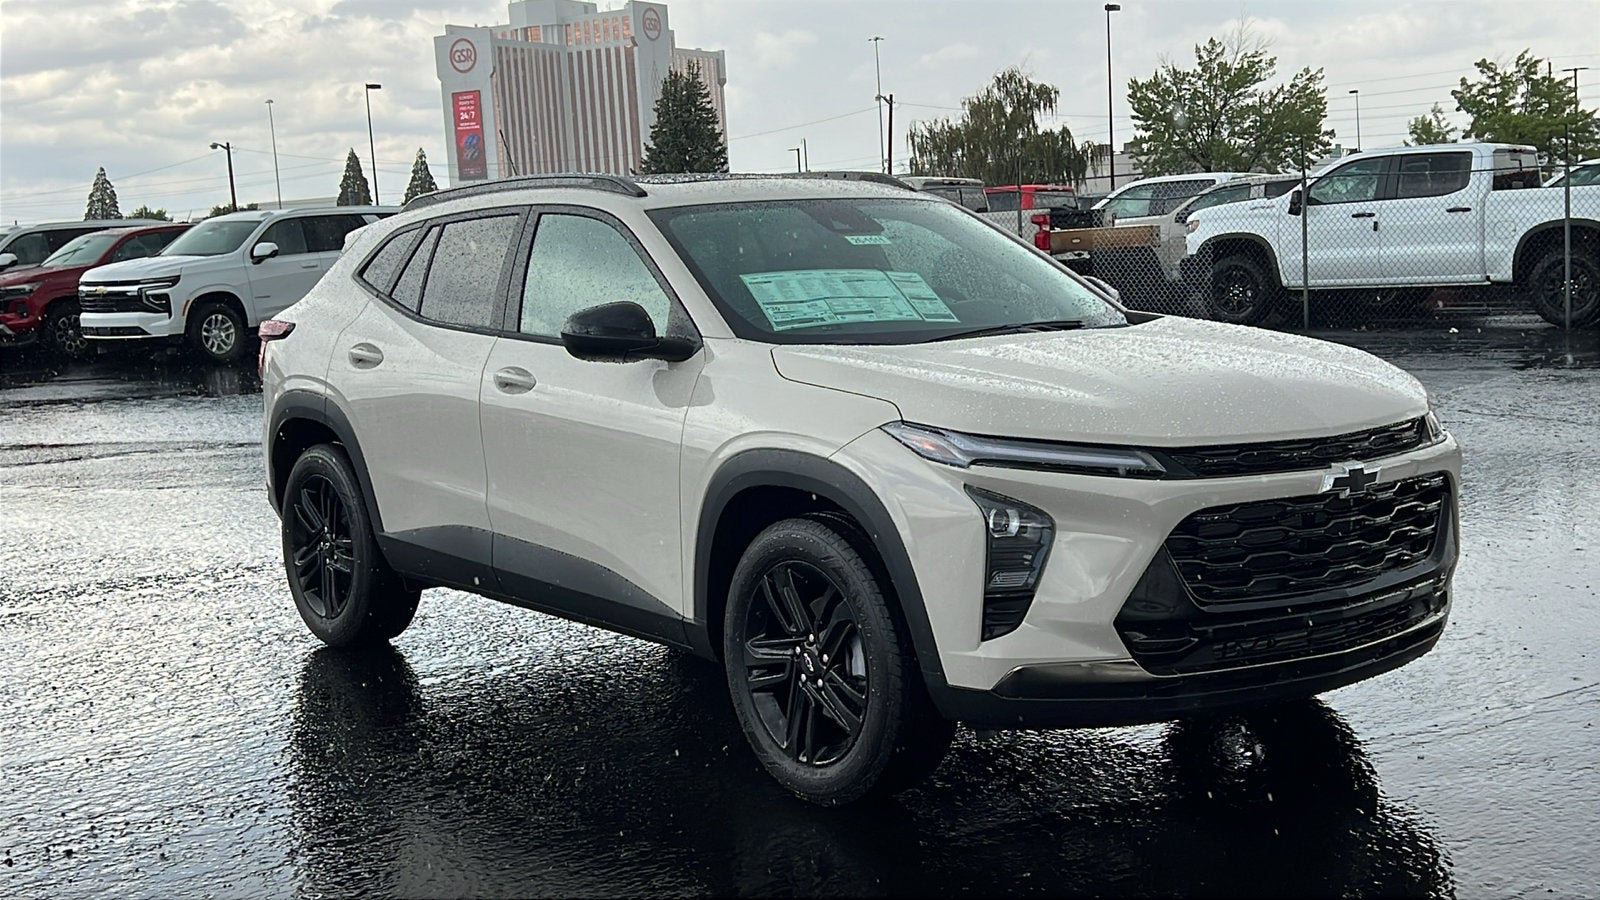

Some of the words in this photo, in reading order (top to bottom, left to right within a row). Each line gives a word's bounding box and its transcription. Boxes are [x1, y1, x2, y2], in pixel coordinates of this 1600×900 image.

[645, 17, 659, 32] GSR
[453, 48, 473, 63] GSR
[460, 111, 475, 120] 24/7
